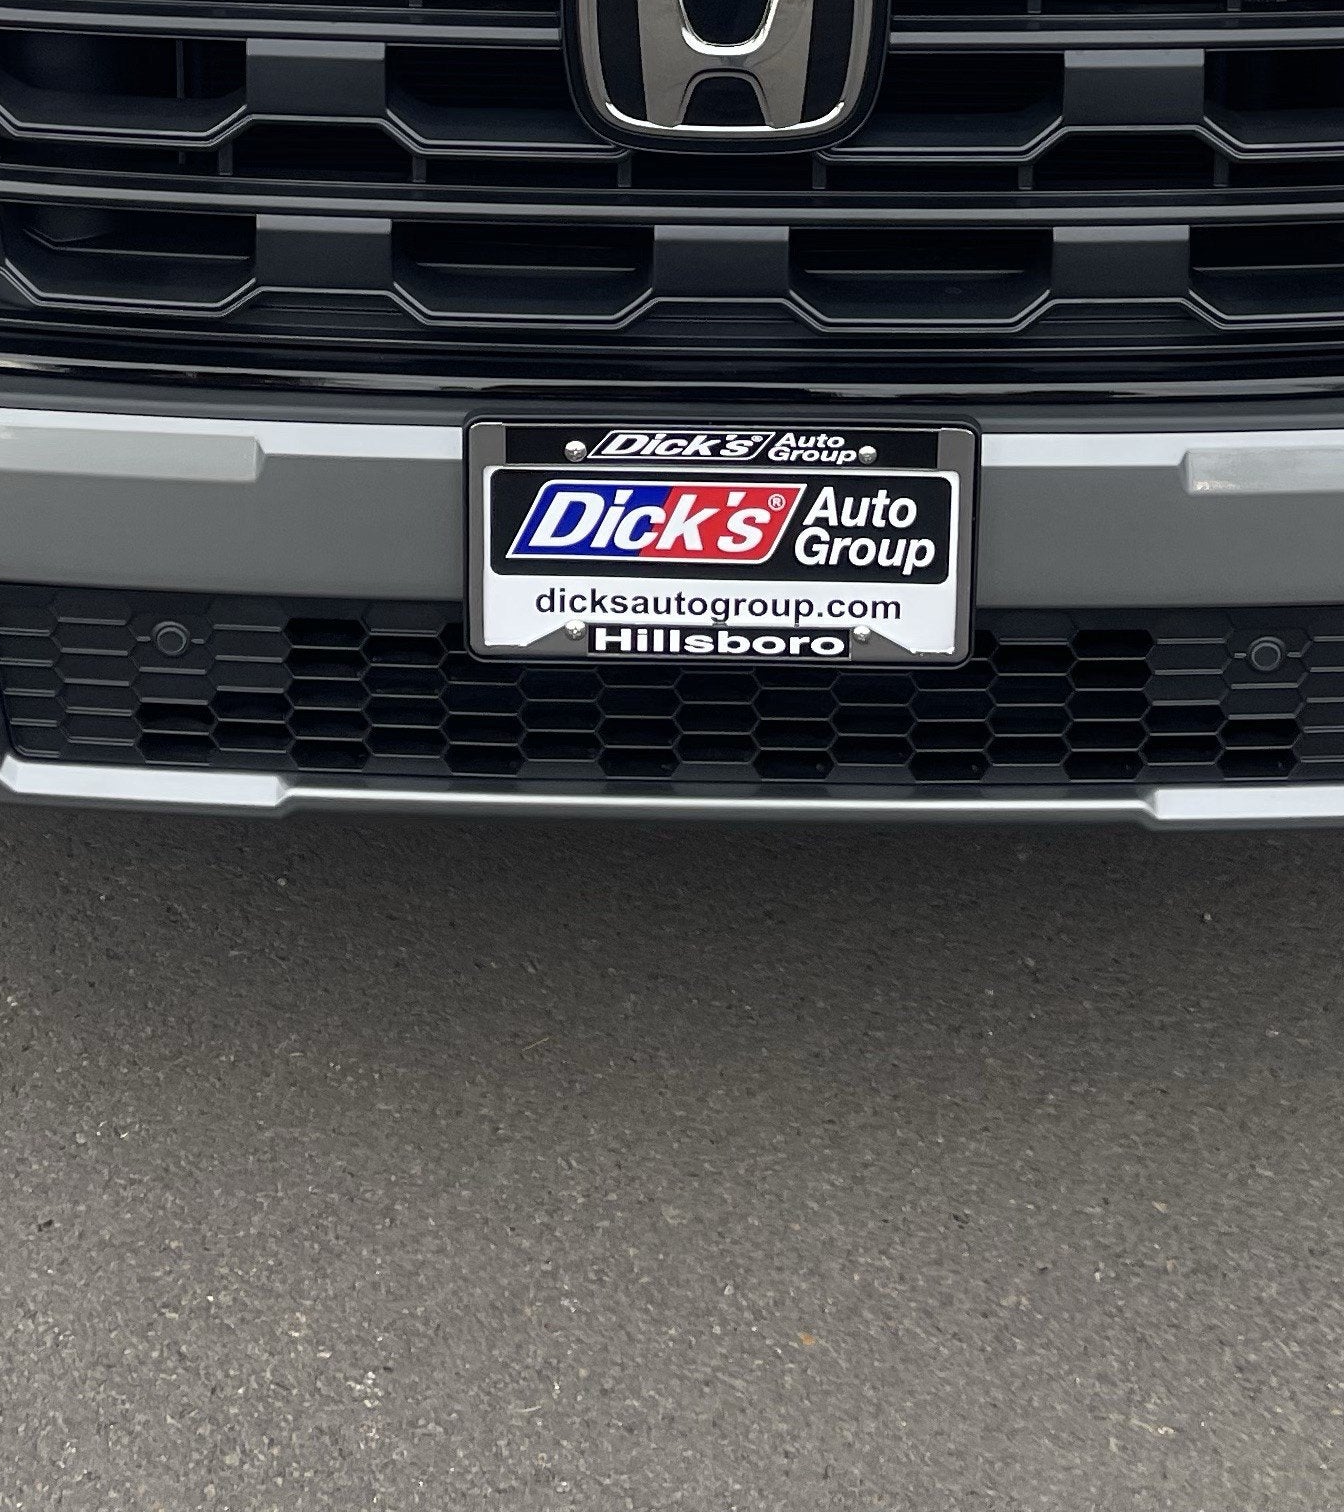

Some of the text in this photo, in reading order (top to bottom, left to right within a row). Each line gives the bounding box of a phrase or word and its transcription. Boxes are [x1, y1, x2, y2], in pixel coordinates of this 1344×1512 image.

[767, 446, 857, 465] Group
[774, 432, 845, 448] Auto
[802, 486, 917, 528] Auto
[794, 526, 936, 575] Group
[534, 587, 902, 624] dicksautogroup.com
[593, 627, 846, 656] Hillsboro
